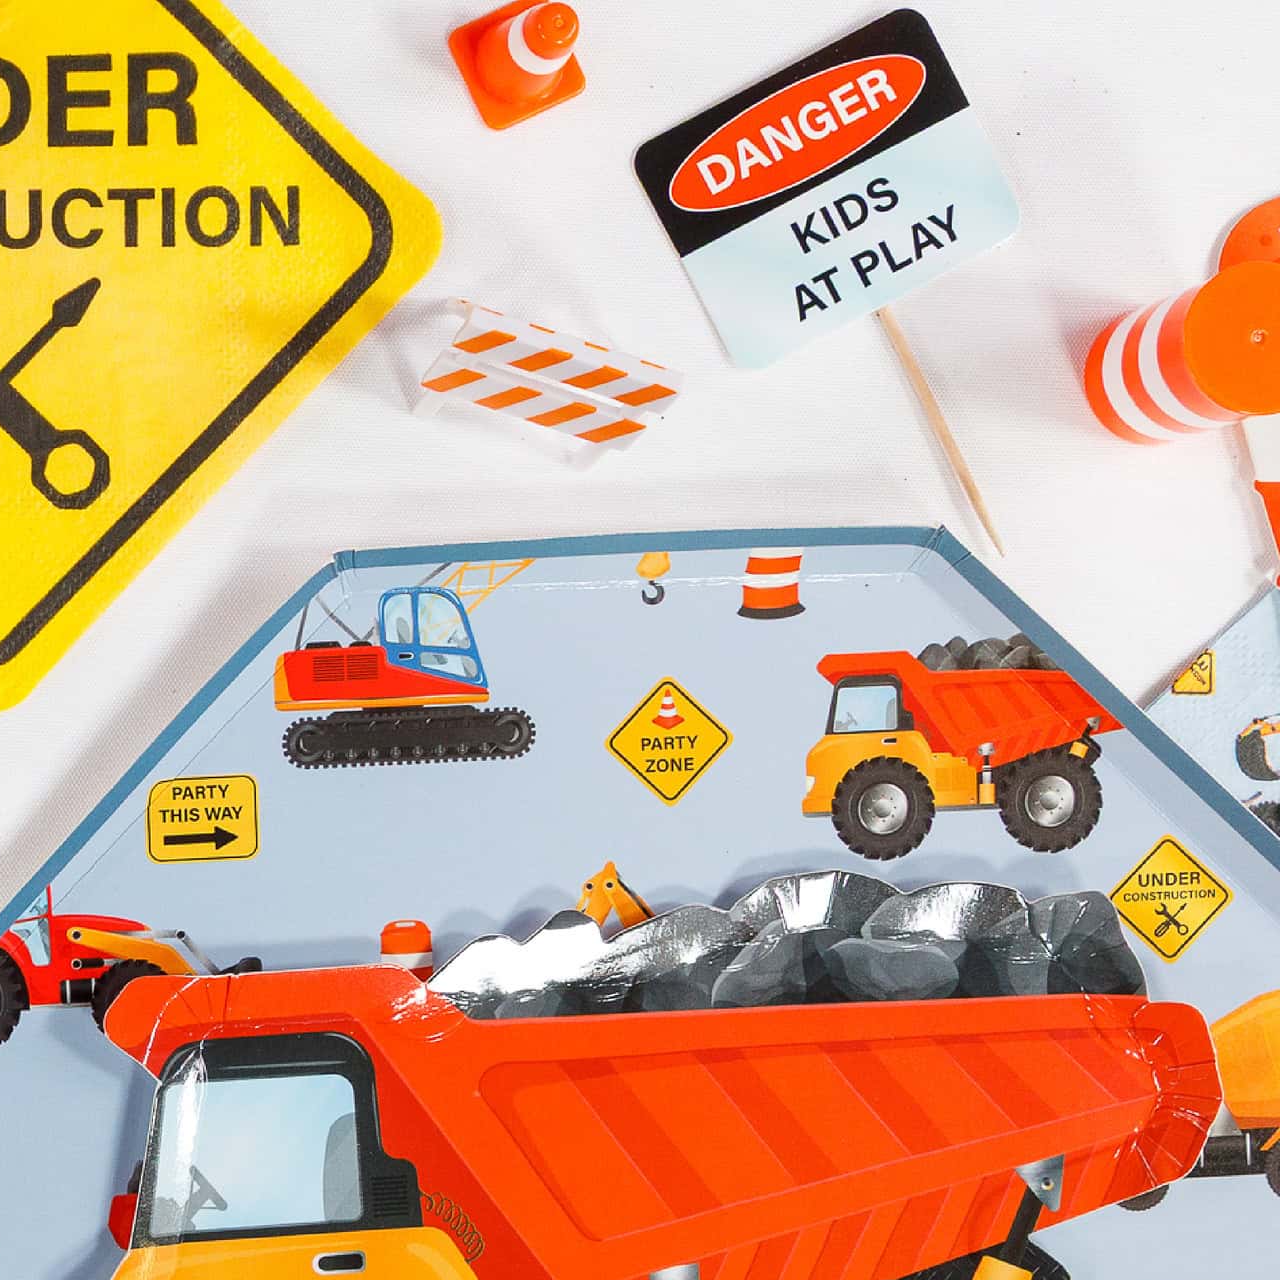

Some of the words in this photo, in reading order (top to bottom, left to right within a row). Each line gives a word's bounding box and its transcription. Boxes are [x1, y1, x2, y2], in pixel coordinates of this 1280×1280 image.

[696, 68, 898, 195] DANGER
[790, 177, 899, 254] KIDS
[794, 266, 842, 322] AT
[850, 204, 959, 288] PLAY
[641, 735, 698, 751] PARTY
[645, 757, 694, 773] ZONE
[172, 784, 229, 801] PARTY
[159, 807, 200, 823] THIS
[204, 806, 242, 821] WAY
[1138, 871, 1201, 888] UNDER
[1123, 889, 1216, 902] CONSTRUCTION
